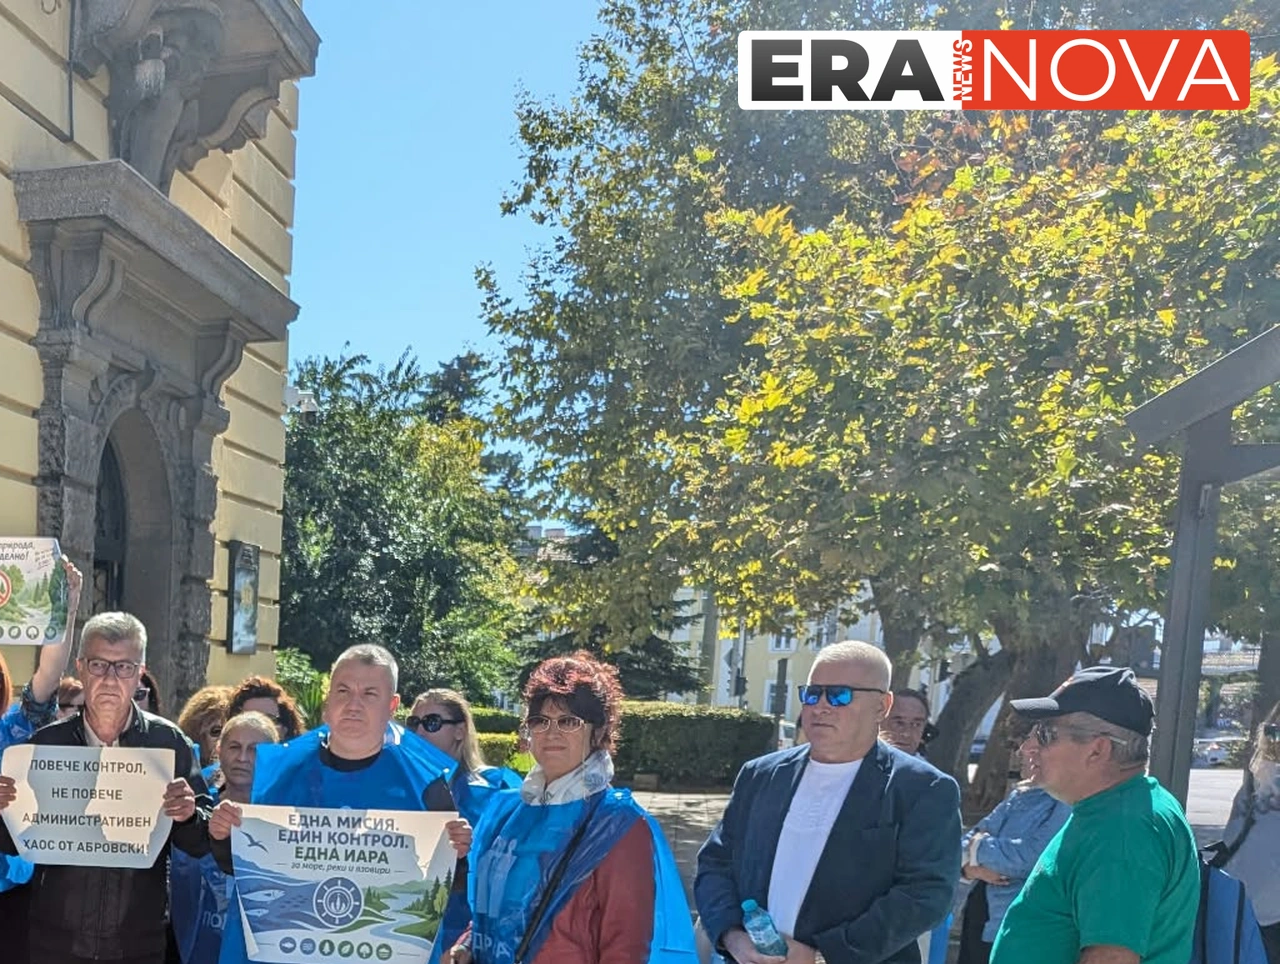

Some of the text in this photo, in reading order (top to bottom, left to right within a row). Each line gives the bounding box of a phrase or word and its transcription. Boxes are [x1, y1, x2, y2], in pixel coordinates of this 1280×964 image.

[30, 759, 147, 775] ПОВЕЧЕ КОНТРОЛ,
[51, 787, 123, 800] НЕ ПОВЕЧЕ
[22, 813, 151, 827] АДМИНИСТРАТИВЕН
[288, 814, 400, 831] ЕДНА МИСИЯ.
[23, 839, 55, 851] ХАОС
[58, 840, 73, 852] ОТ
[278, 830, 409, 849] ЕДИН КОНТРОЛ.
[294, 846, 389, 865] ЕДНА ИАРА
